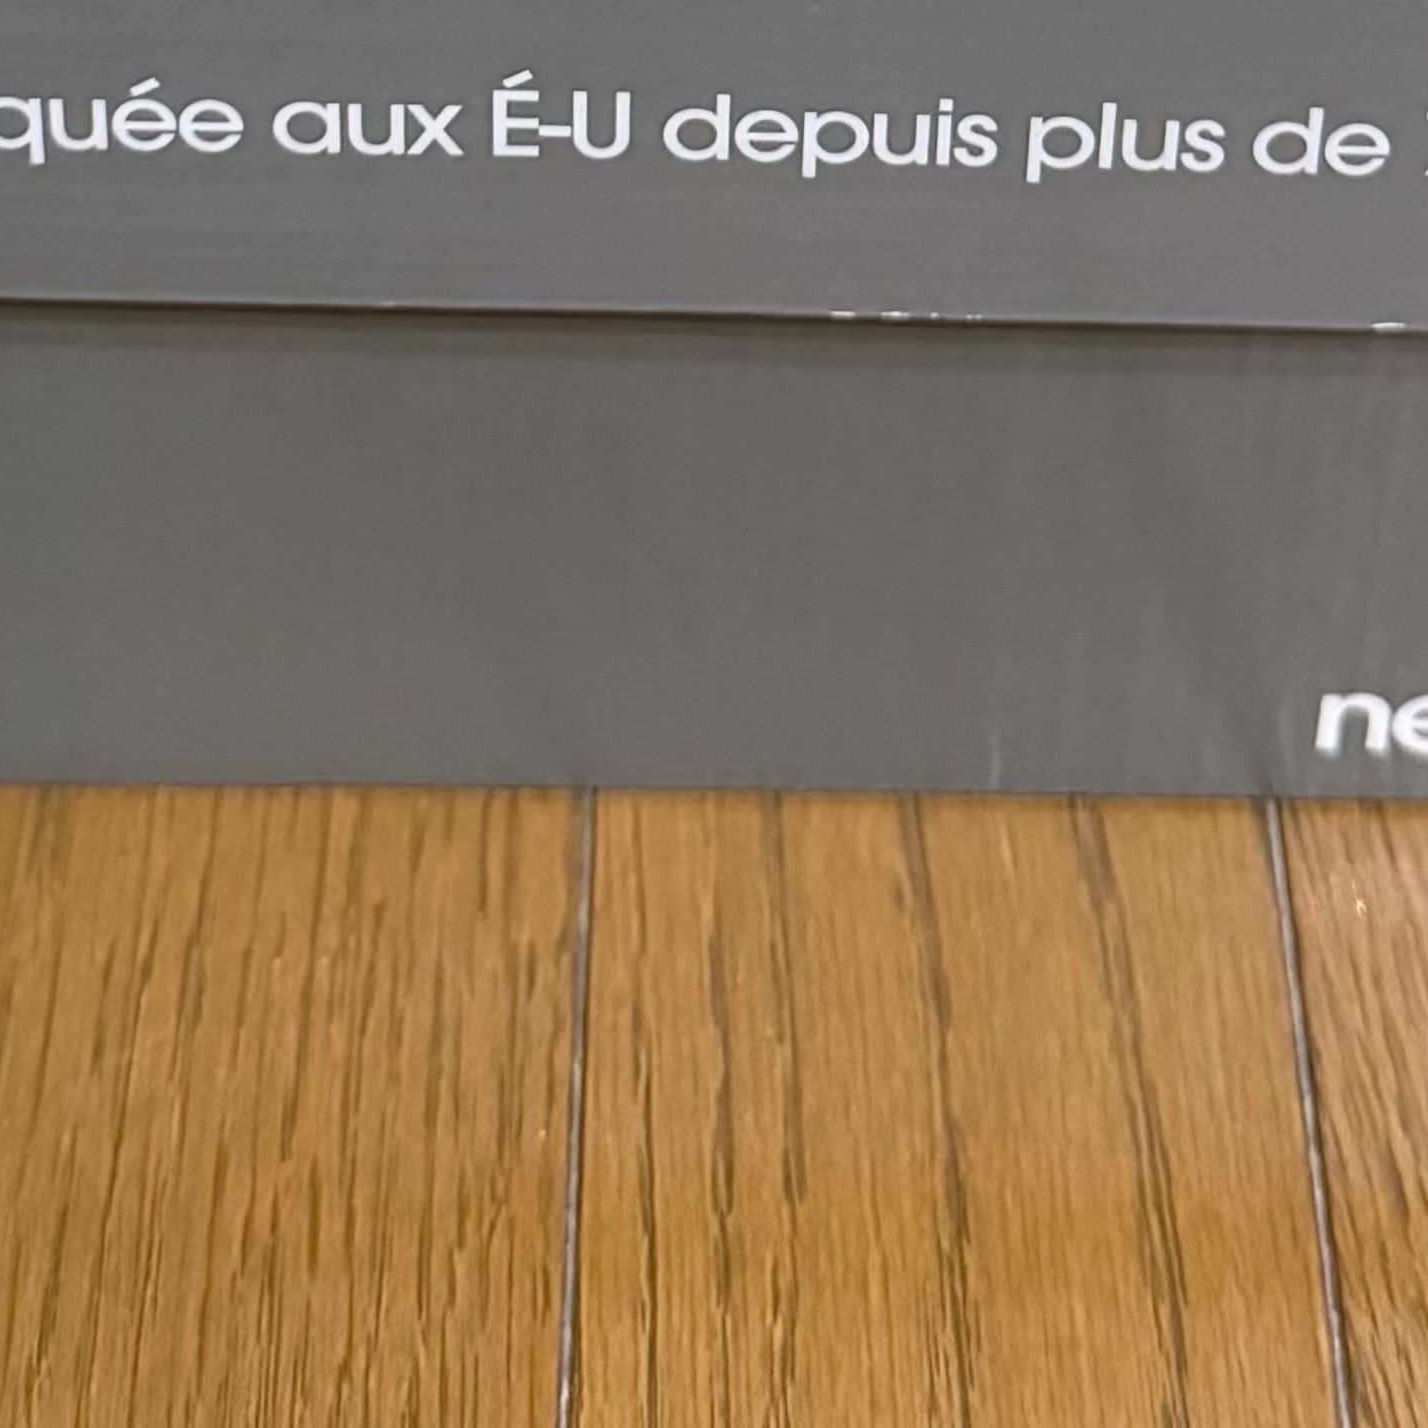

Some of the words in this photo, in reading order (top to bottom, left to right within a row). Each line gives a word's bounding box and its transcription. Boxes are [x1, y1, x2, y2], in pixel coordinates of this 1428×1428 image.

[272, 100, 464, 157] aux
[492, 68, 631, 160] É-U
[662, 93, 999, 180] depuis
[1025, 102, 1226, 185] plus
[1252, 106, 1391, 177] de
